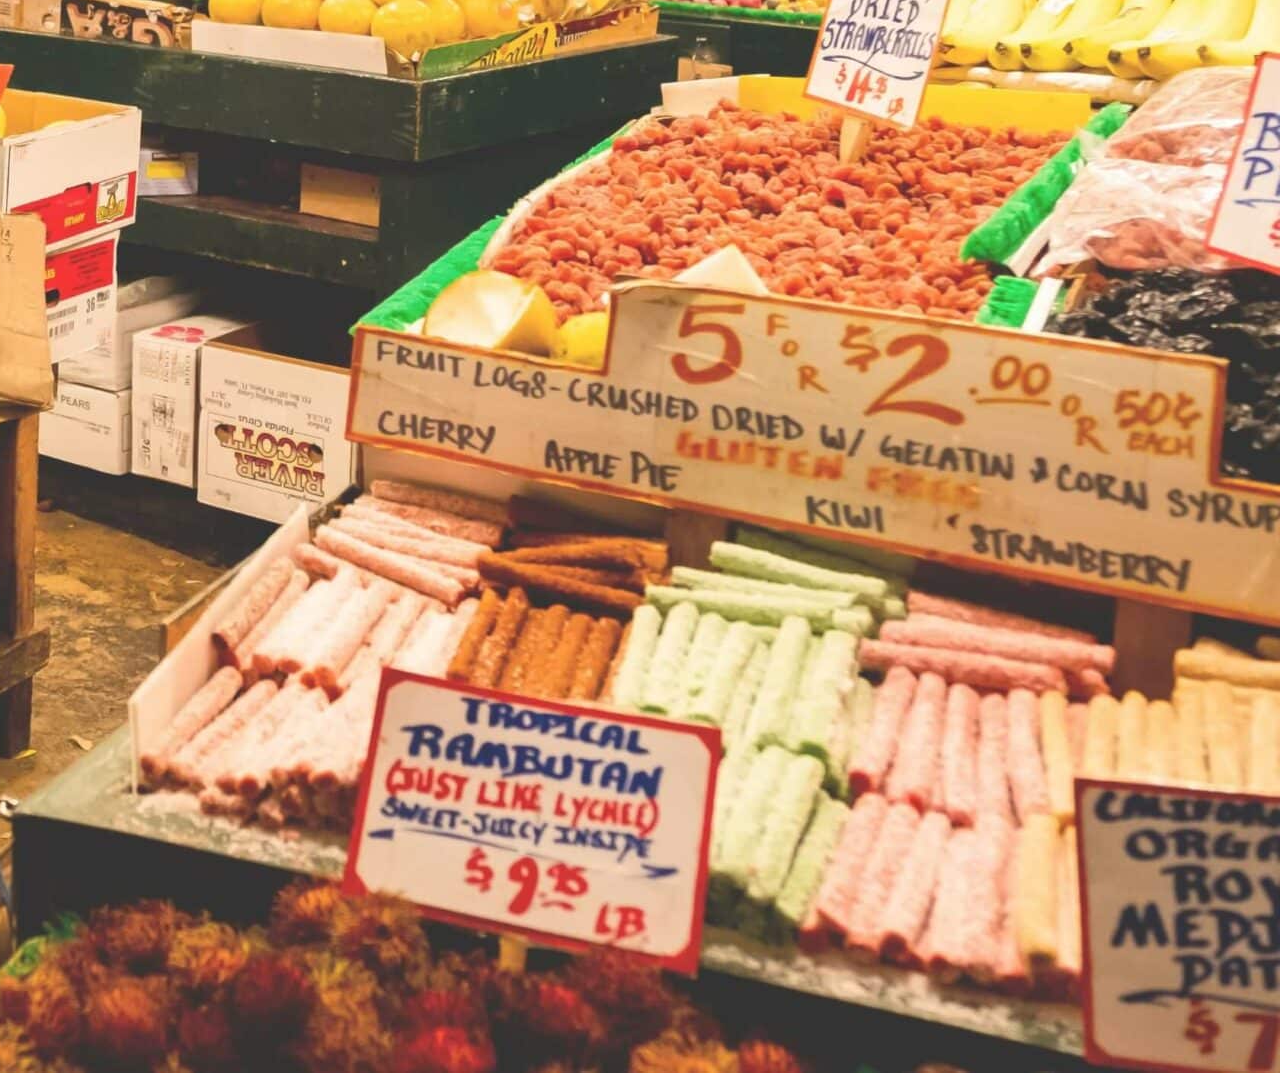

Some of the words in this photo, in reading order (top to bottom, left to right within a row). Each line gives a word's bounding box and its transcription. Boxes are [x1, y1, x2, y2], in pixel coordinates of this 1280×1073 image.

[821, 18, 937, 64] STRAWBERRIES
[85, 296, 96, 314] 36
[670, 302, 746, 386] 5
[766, 313, 828, 395] FOR
[1060, 393, 1112, 456] OR
[60, 394, 91, 411] PEARS
[237, 414, 263, 428] Citrus
[215, 424, 314, 469] SCOTT
[265, 420, 295, 436] Florida
[376, 339, 465, 380] FRUIT
[568, 378, 700, 423] CRUSHED
[711, 403, 805, 441] DRIED
[820, 425, 866, 458] W/
[880, 434, 1015, 482] GELATIN
[1057, 464, 1149, 512] CORN
[1167, 489, 1280, 535] SYRUP
[378, 411, 496, 455] CHERRY
[675, 430, 845, 483] GLUTEN
[1127, 432, 1197, 460] EACH
[234, 452, 325, 497] RIVER
[544, 440, 621, 479] APPLE
[631, 452, 683, 492] PIE
[805, 495, 884, 533] KIWI
[971, 522, 1191, 593] STRAWBERRY
[461, 696, 650, 755] TROPICAL
[401, 723, 664, 798] RAMBUTAN
[385, 759, 470, 803] (JUST
[476, 779, 543, 813] LIKE
[554, 792, 660, 838] LYCHEE)
[554, 826, 653, 862] INSIDE
[594, 902, 647, 942] LB
